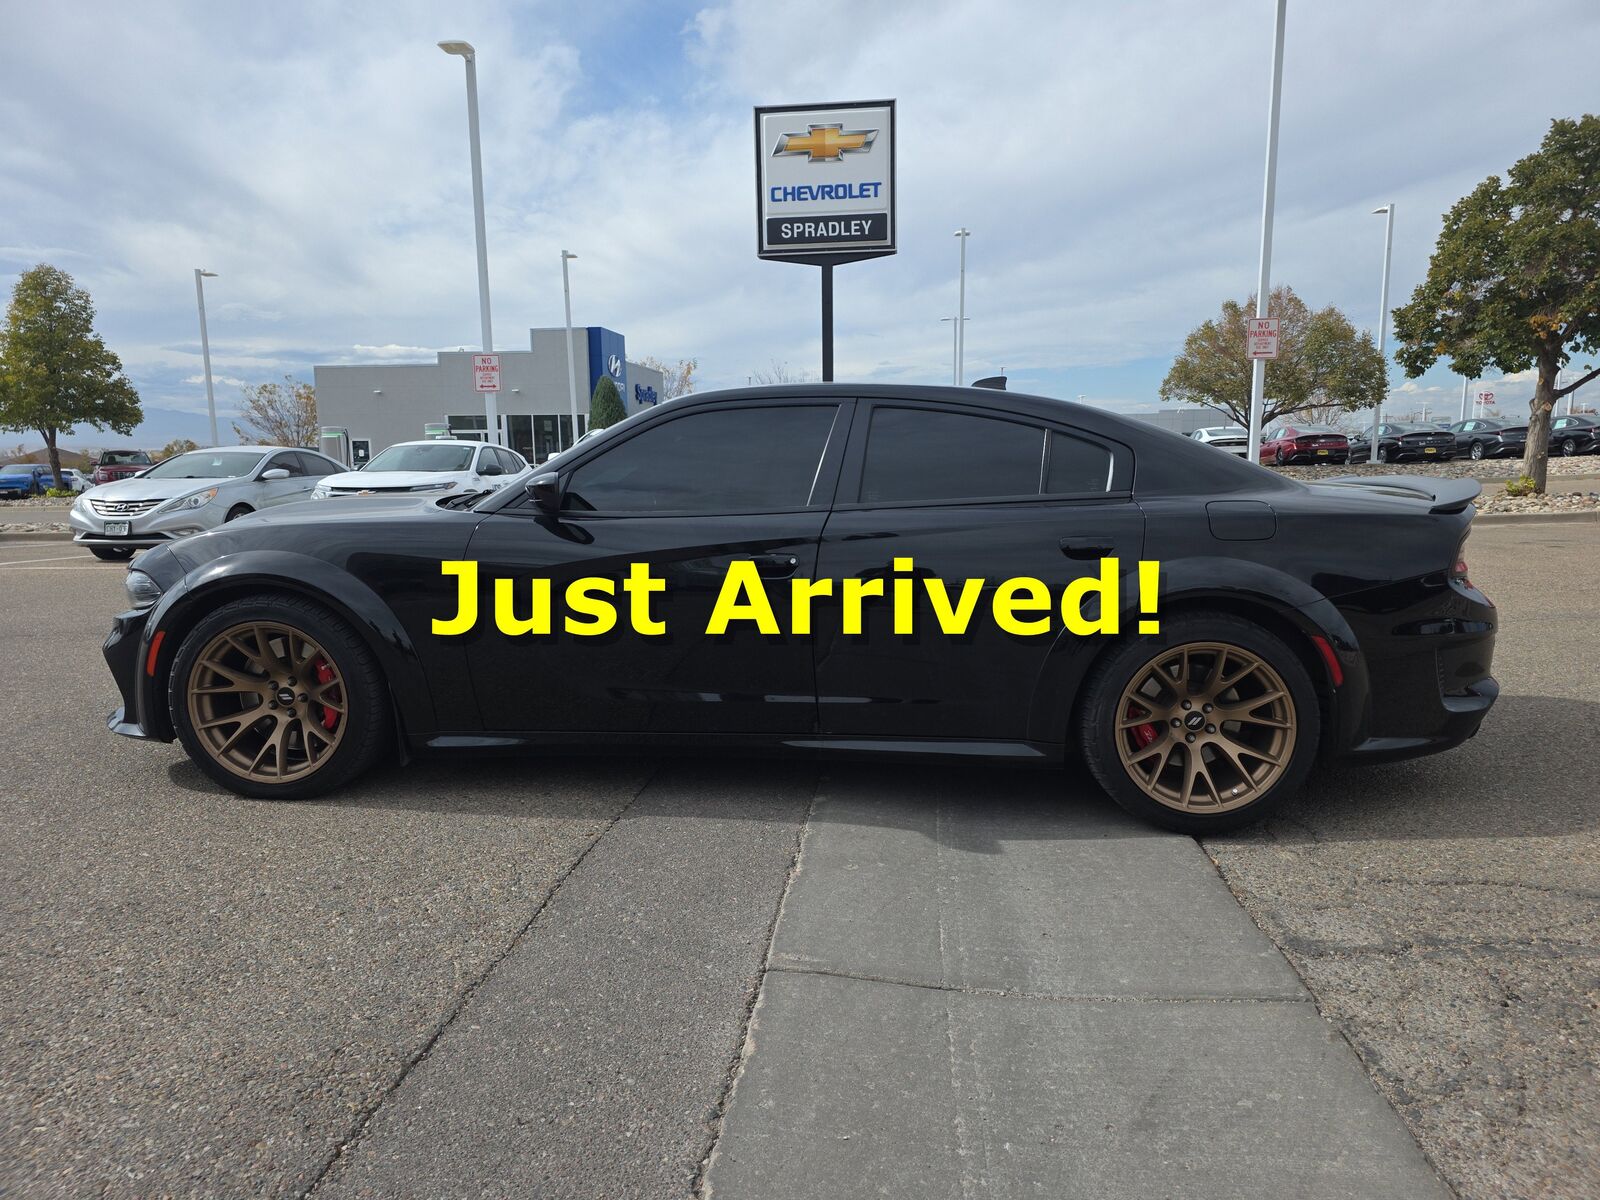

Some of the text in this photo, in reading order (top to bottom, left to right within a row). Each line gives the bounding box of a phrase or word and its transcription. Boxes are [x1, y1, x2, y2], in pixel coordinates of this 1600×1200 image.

[770, 182, 882, 202] CHEVROLET
[781, 220, 872, 239] SPRADLEY
[1257, 321, 1270, 330] NO
[1250, 330, 1277, 338] PARKING
[481, 357, 492, 365] NO
[475, 365, 498, 373] PARKING
